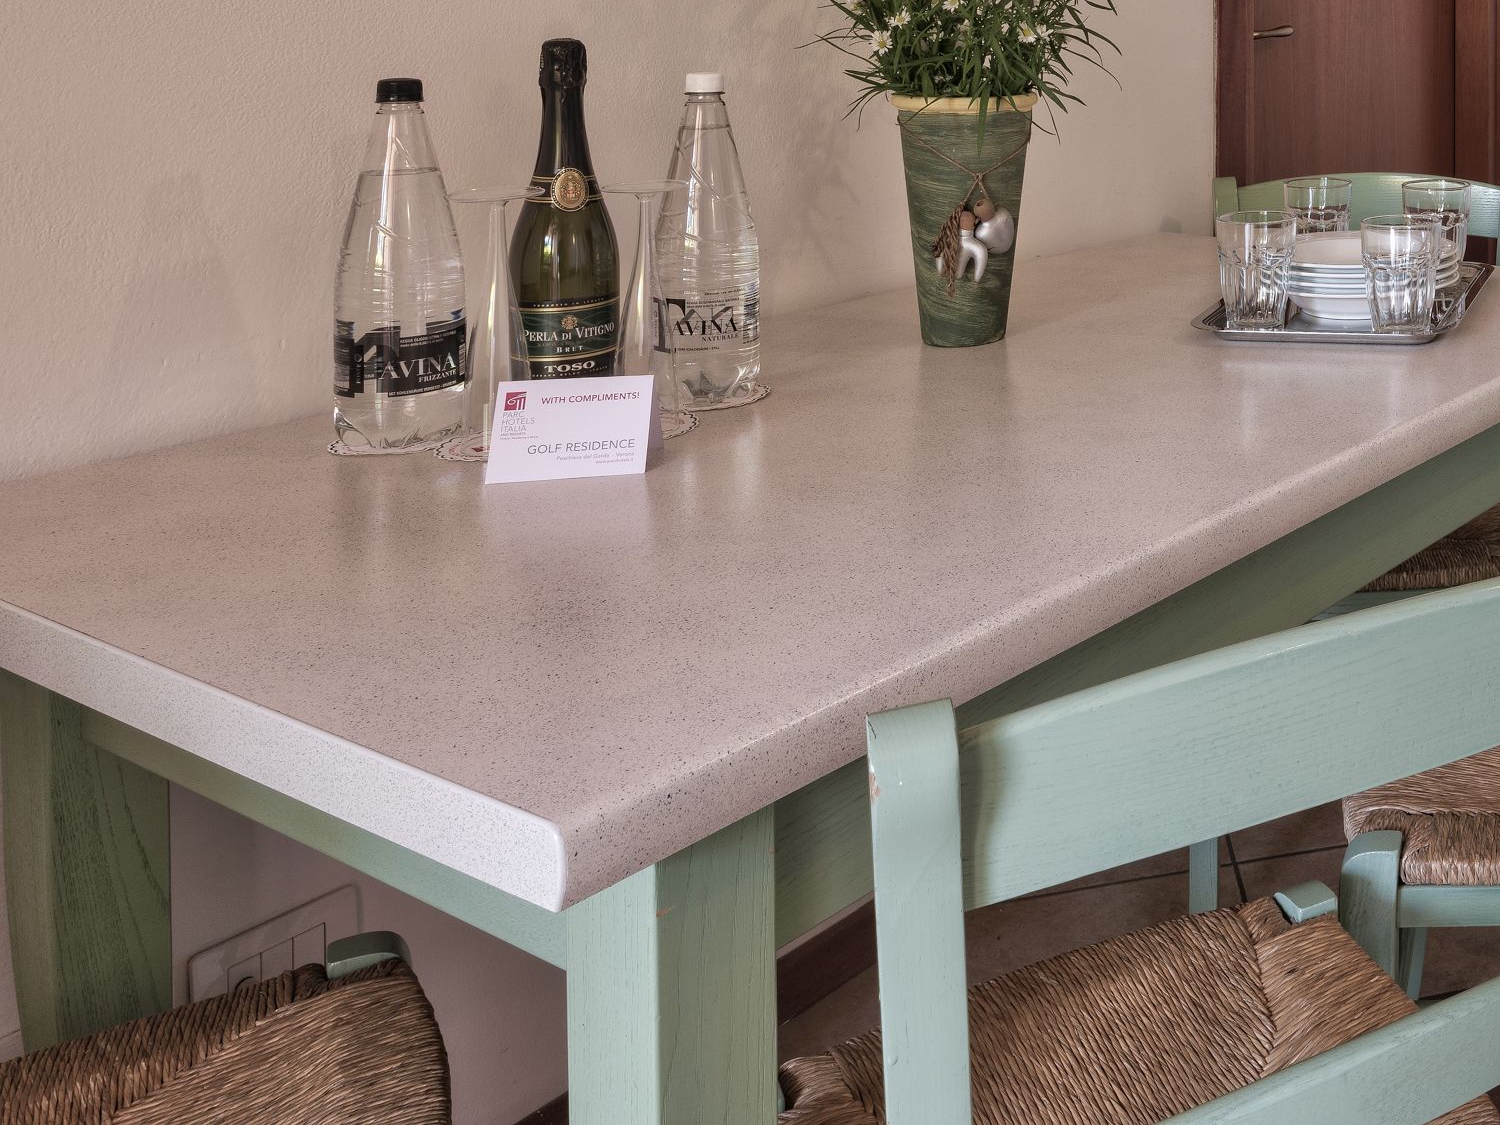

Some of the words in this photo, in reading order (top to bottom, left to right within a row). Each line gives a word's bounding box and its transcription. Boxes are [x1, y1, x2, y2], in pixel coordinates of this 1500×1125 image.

[522, 329, 558, 342] PERLA
[575, 322, 615, 339] VITIGNO
[702, 333, 739, 343] NATURALE
[556, 345, 583, 353] BRUT
[544, 360, 596, 373] TOSO
[418, 368, 457, 383] FRIZZANTE
[541, 396, 566, 405] WITH
[568, 392, 640, 404] COMPLIMENTS!
[501, 417, 535, 426] HOTELS
[500, 425, 527, 433] ITALIA
[527, 443, 562, 455] GOLF
[565, 438, 636, 452] RESIDENCE
